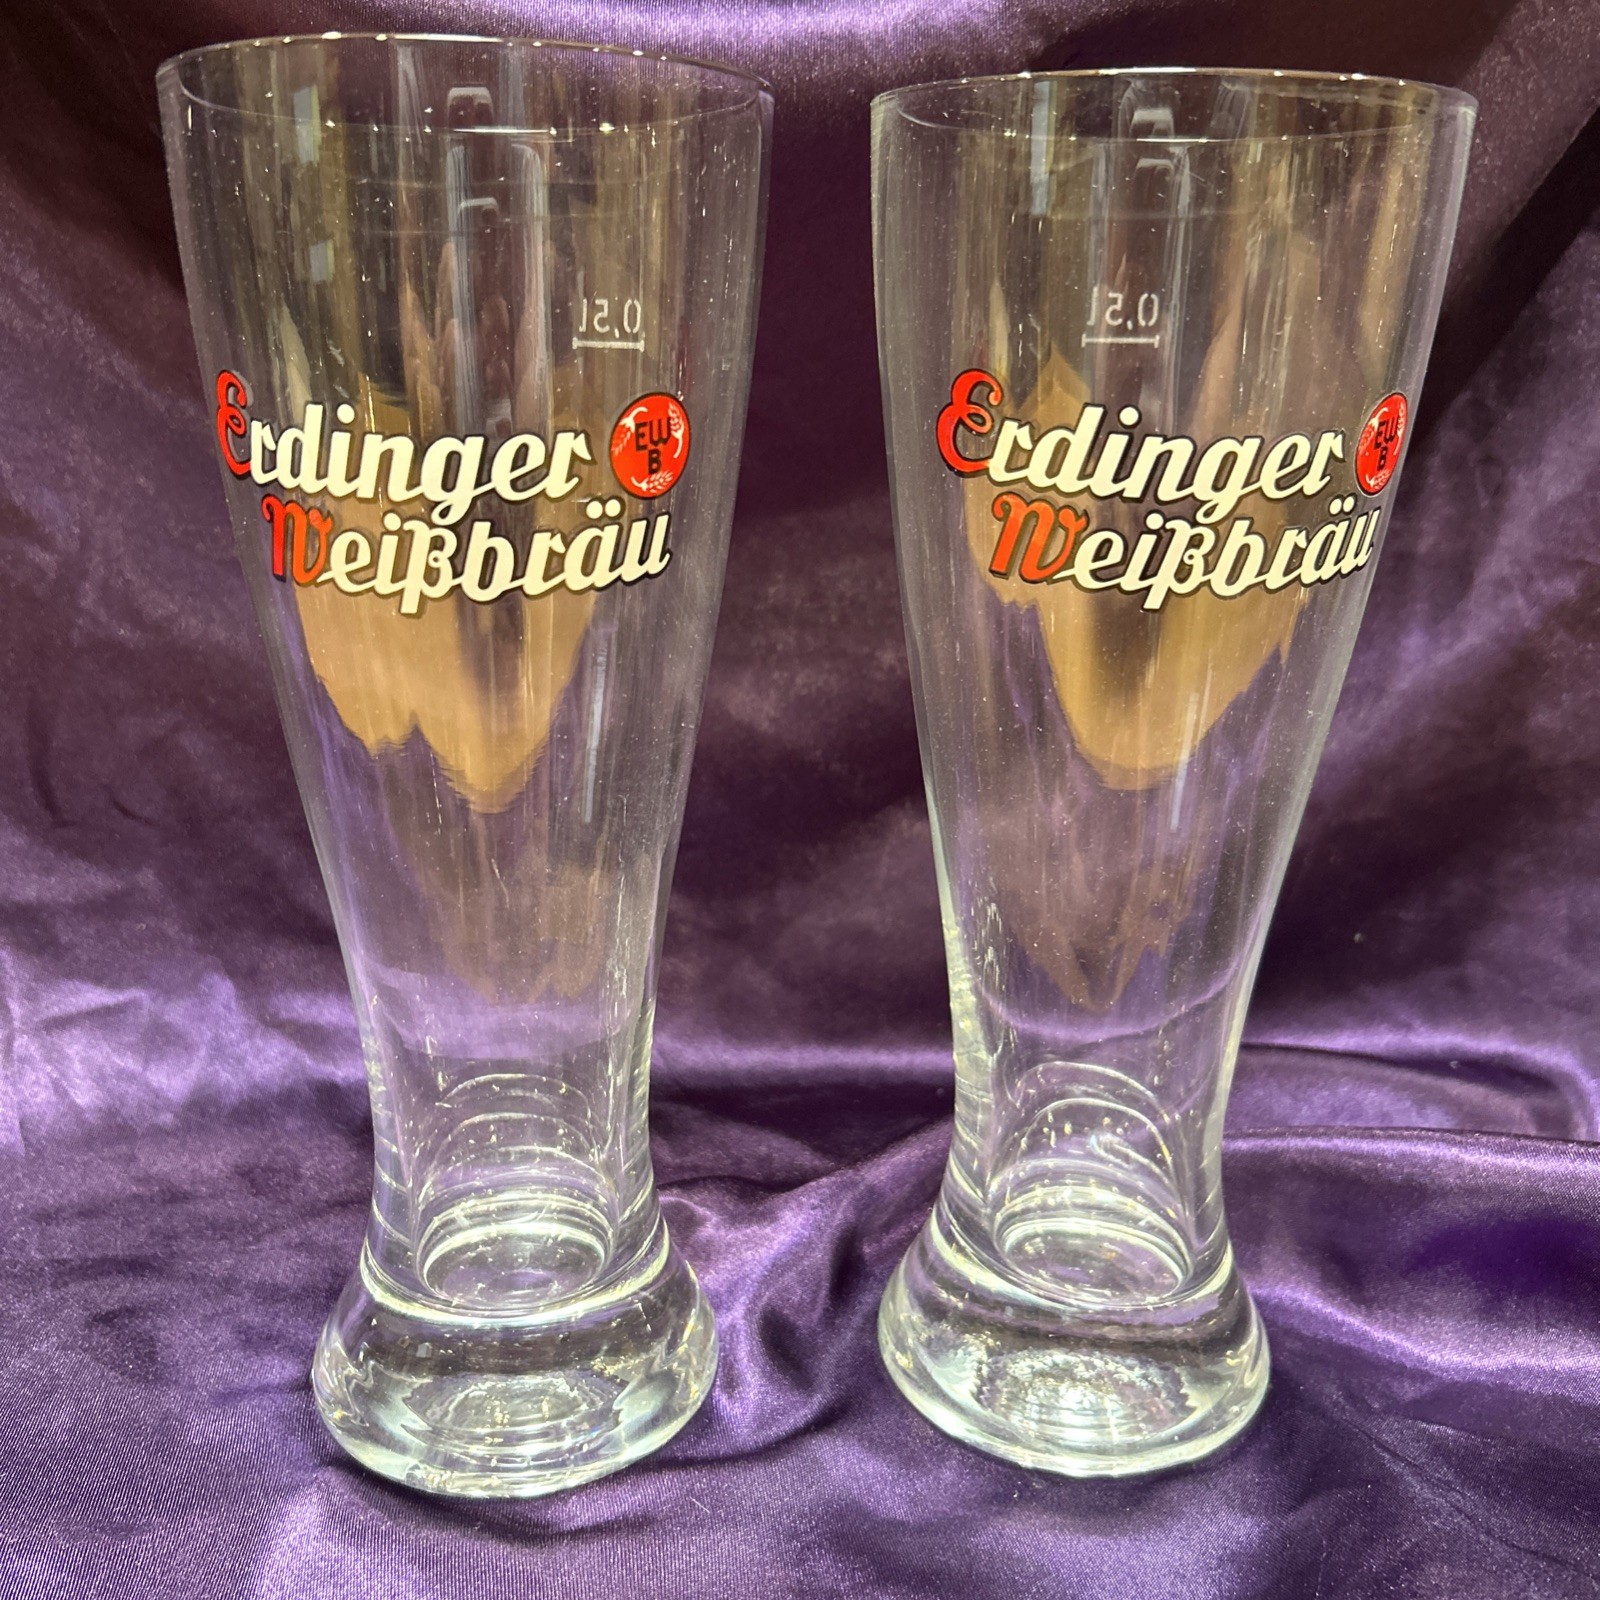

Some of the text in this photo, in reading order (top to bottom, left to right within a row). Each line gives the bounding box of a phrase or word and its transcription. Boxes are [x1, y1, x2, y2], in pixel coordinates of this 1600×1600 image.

[216, 369, 594, 525] Erdinger
[648, 448, 661, 475] B
[936, 369, 1344, 524] Erdinger
[262, 495, 671, 615] Weißbräu
[989, 494, 1381, 610] Weißbräu
